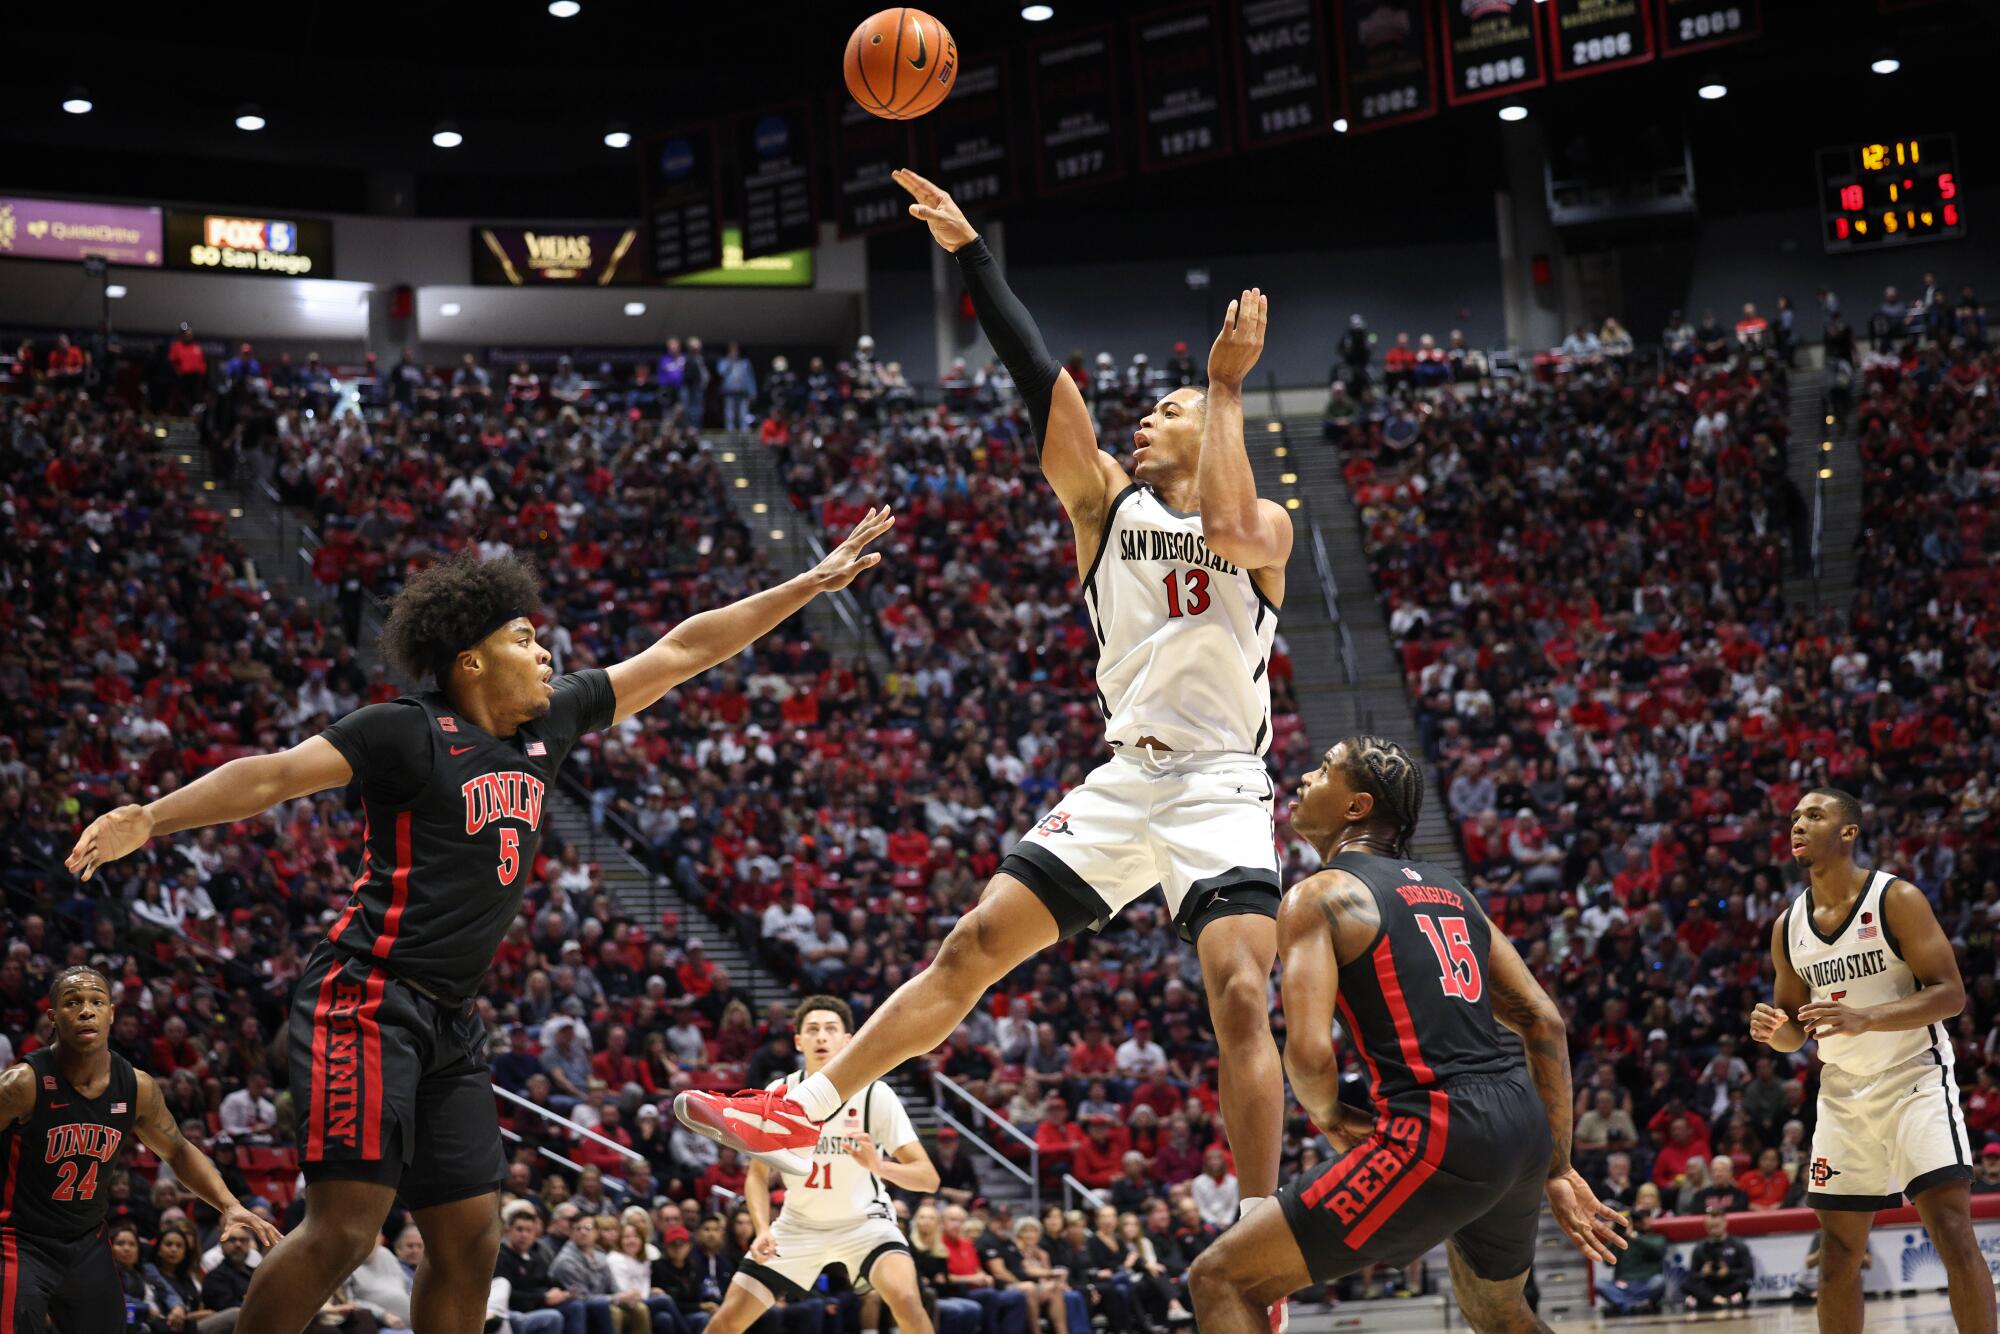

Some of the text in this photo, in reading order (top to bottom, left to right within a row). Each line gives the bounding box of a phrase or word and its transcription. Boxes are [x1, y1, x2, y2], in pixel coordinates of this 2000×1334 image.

[1246, 21, 1311, 54] WAC
[1571, 31, 1632, 66] 2006
[1464, 55, 1526, 90] 2006
[1862, 140, 1920, 170] 12:11
[1938, 173, 1956, 200] 5
[208, 217, 291, 252] FOX 5
[221, 247, 257, 268] San
[257, 250, 312, 275] Diego
[1120, 529, 1147, 560] SAN
[1150, 530, 1194, 564] DIEGO
[1162, 568, 1211, 618] 13
[461, 770, 545, 836] UNLV
[497, 827, 520, 886] 5
[1395, 885, 1465, 912] RODRIGUEZ
[1413, 913, 1482, 1004] 15
[1812, 957, 1846, 987] DIEGO
[1847, 949, 1887, 980] STATE
[45, 1123, 122, 1164] UNLV
[51, 1161, 99, 1201] 24
[804, 1160, 833, 1189] 21
